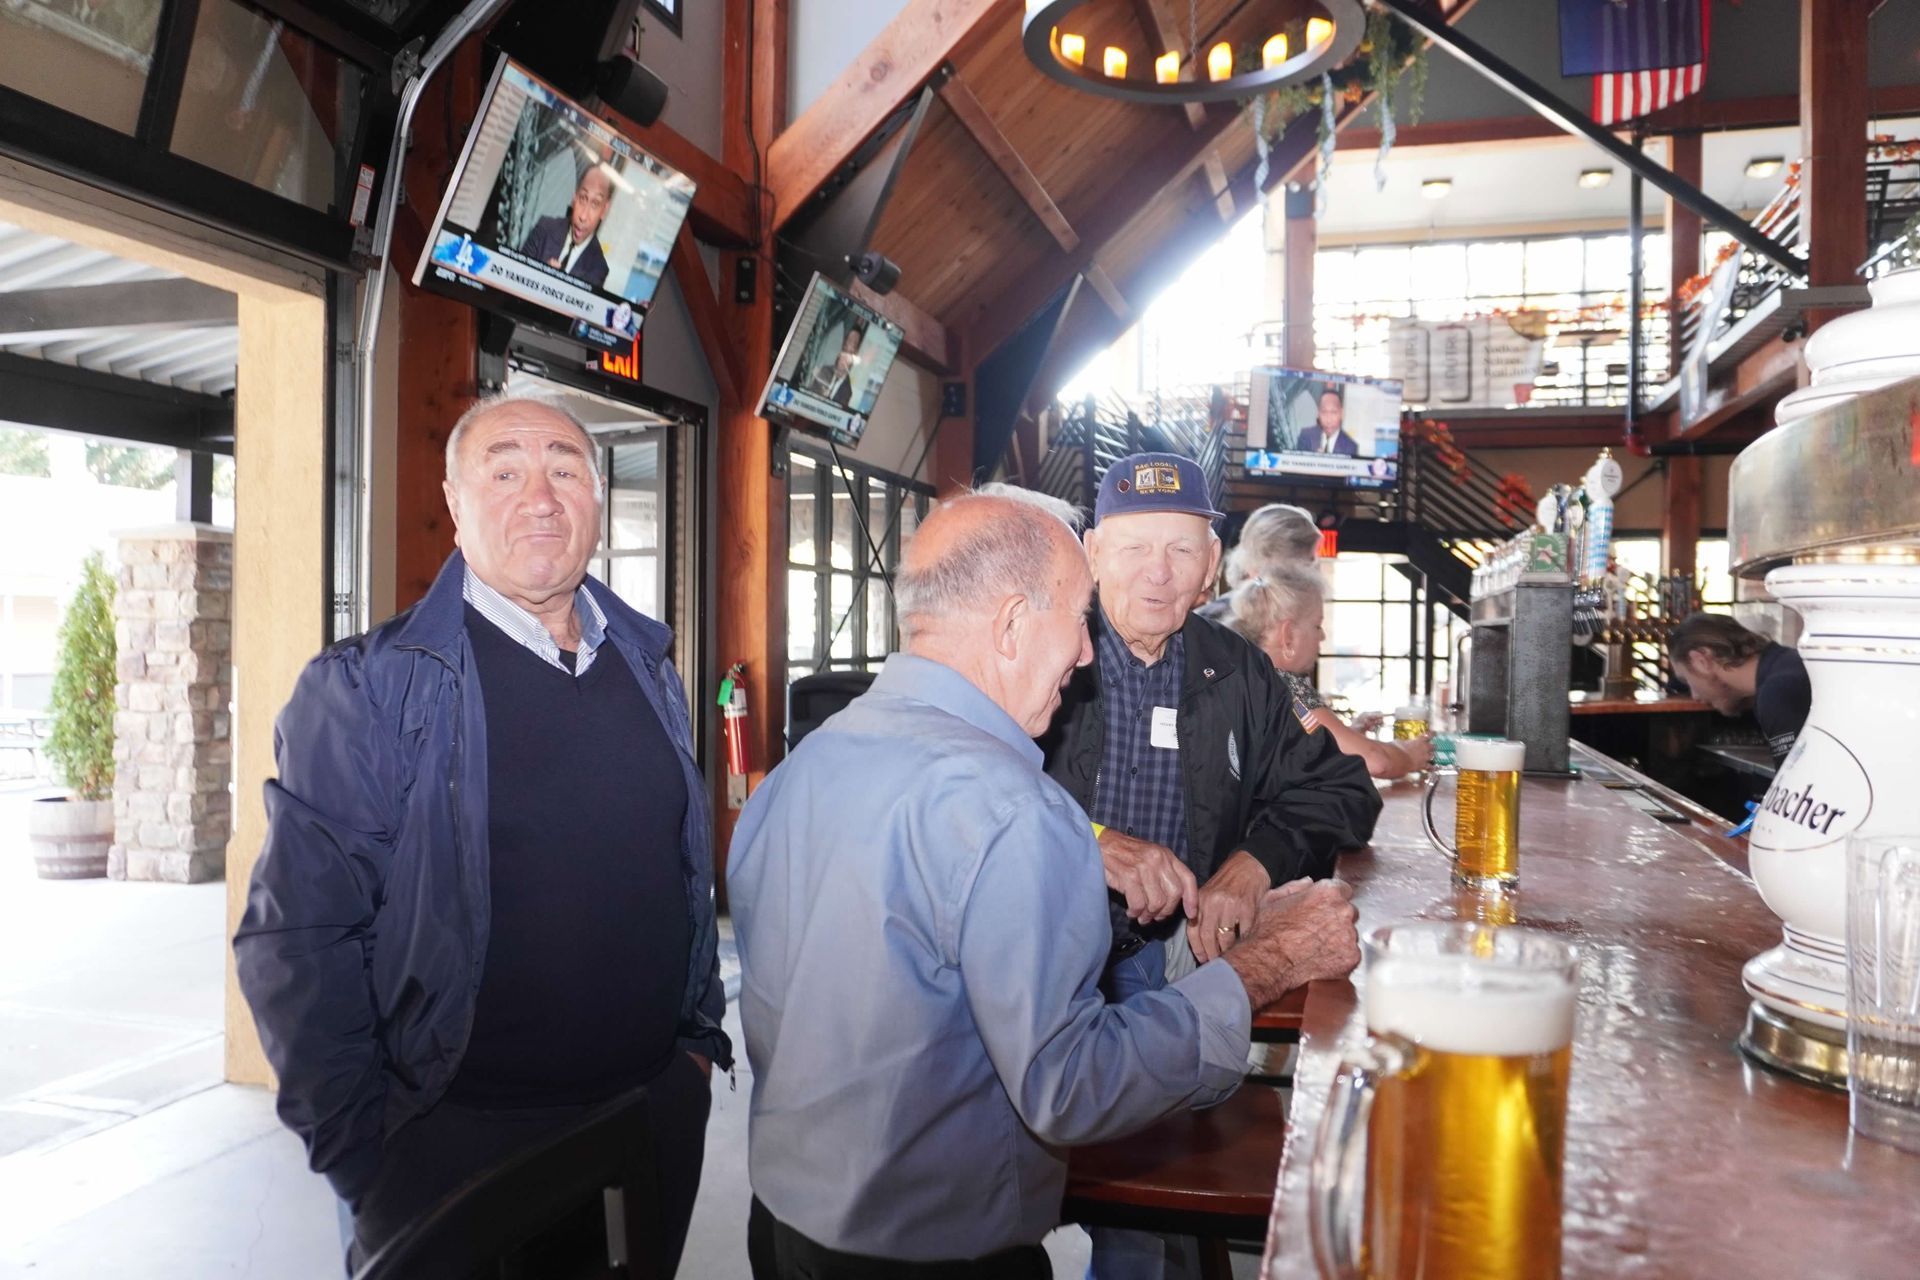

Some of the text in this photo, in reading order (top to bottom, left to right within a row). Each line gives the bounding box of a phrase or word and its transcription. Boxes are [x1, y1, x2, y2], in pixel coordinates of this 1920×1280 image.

[490, 263, 503, 276] DO
[505, 269, 540, 291] YANKEES
[541, 281, 563, 301] FORCE
[564, 290, 585, 309] GAME
